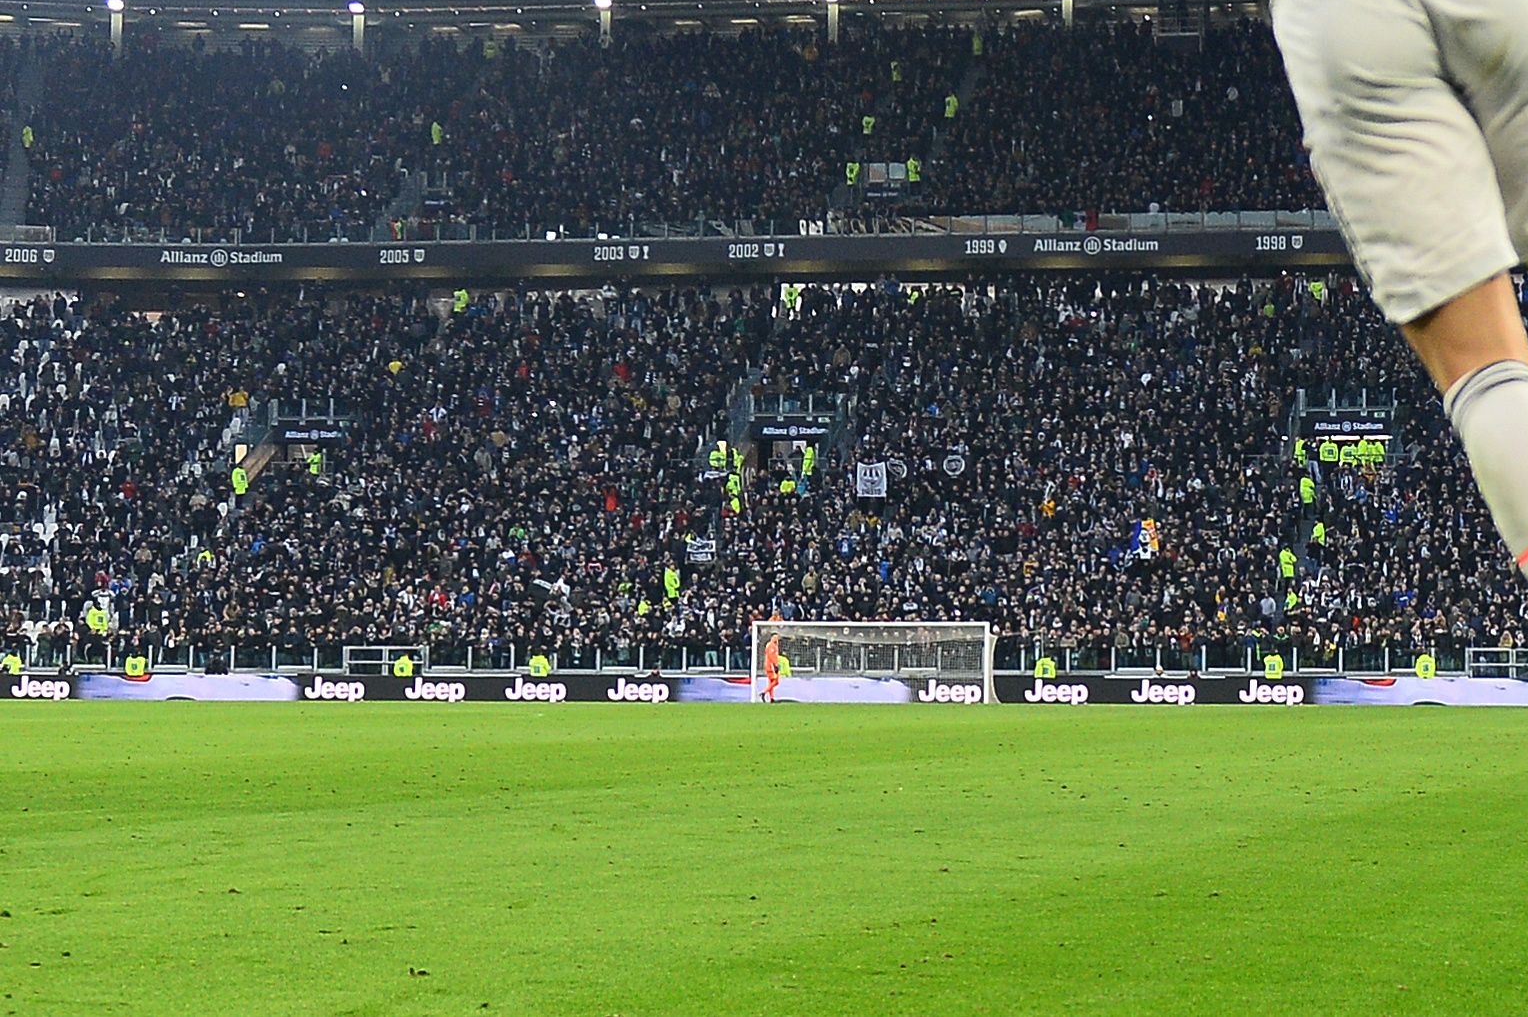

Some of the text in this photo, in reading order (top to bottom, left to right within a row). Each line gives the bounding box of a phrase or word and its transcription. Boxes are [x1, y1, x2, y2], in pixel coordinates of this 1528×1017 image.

[4, 248, 38, 263] 2006
[593, 246, 624, 261] 2003
[728, 243, 760, 259] 2002
[965, 238, 996, 255] 1999
[1034, 236, 1159, 253] Allianz Stadium
[1255, 235, 1287, 251] 1998
[160, 250, 283, 264] Allianz Stadium
[379, 249, 410, 264] 2005
[11, 676, 70, 701] Jeep
[304, 676, 365, 702] Jeep
[404, 676, 466, 702] Jeep
[504, 677, 567, 702] Jeep
[607, 678, 670, 703] Jeep
[918, 679, 982, 705] Jeep
[1024, 679, 1089, 705] Jeep
[1131, 679, 1197, 705] Jeep
[1239, 679, 1305, 705] Jeep
